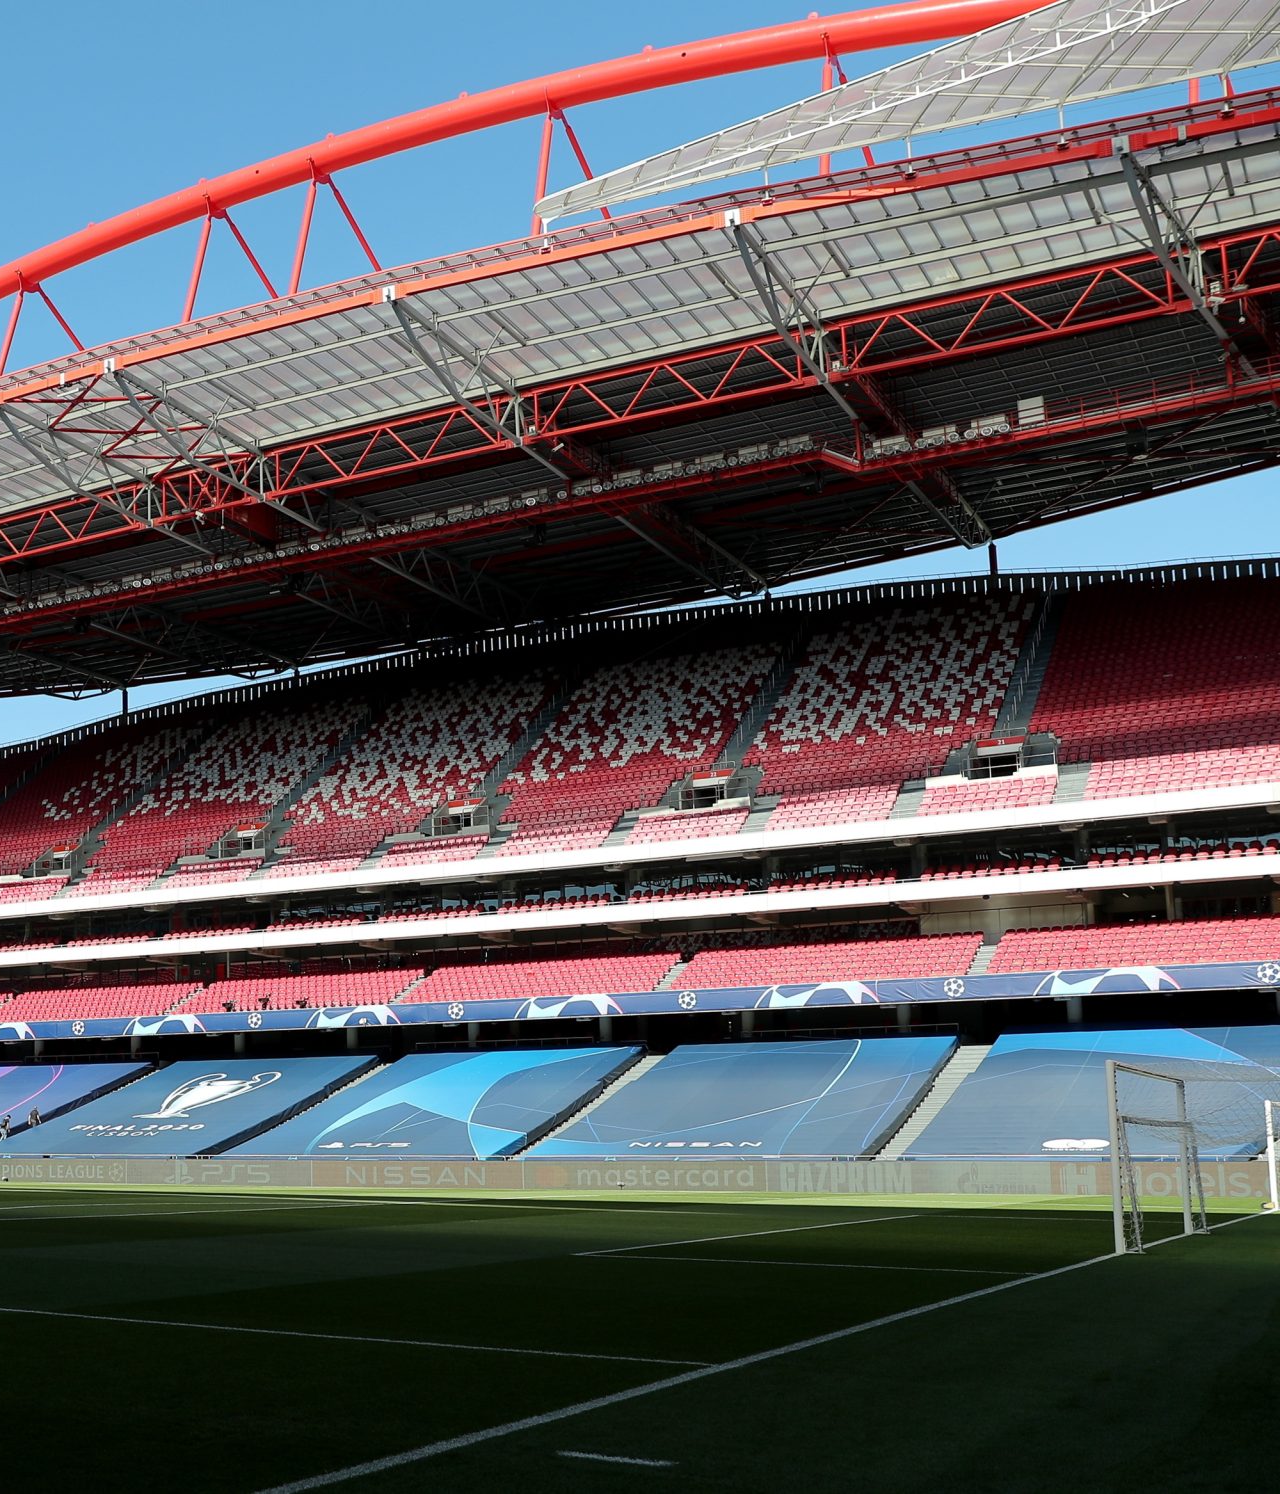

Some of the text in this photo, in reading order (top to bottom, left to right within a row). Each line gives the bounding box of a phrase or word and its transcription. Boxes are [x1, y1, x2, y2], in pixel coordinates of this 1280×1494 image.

[49, 1164, 104, 1179] LEAGUE
[201, 1163, 270, 1184] PS5
[346, 1166, 486, 1185] NISSAN
[577, 1164, 754, 1187] mastercard
[779, 1162, 913, 1193] GAZPROM
